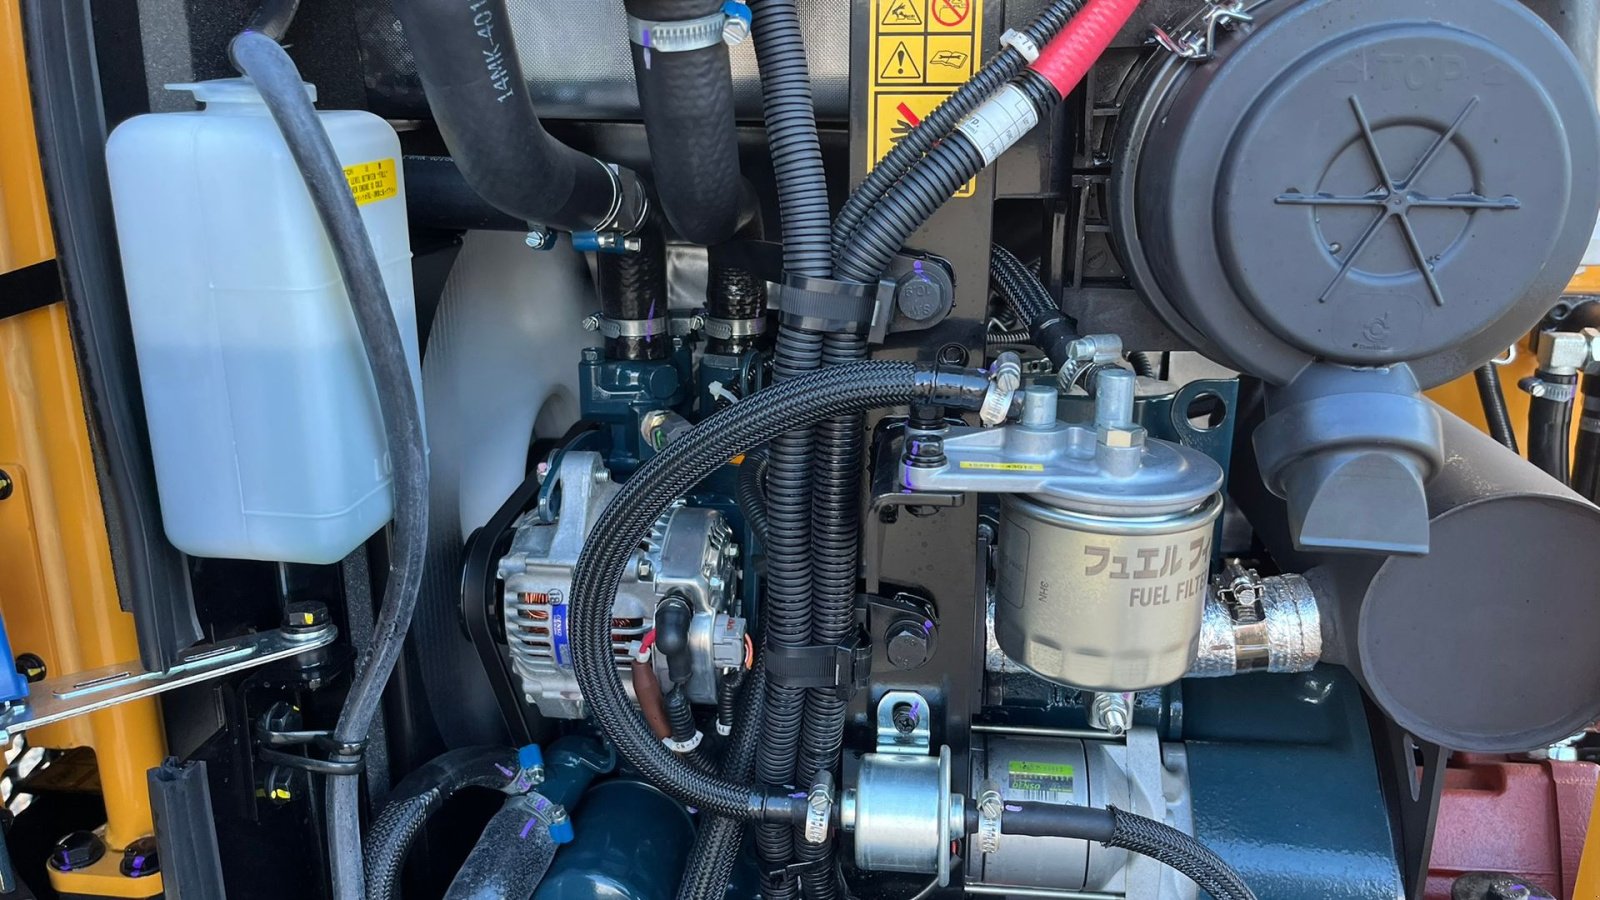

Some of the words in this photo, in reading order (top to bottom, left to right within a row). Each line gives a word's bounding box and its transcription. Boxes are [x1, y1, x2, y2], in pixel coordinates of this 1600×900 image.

[1377, 53, 1467, 91] TOP
[1129, 584, 1170, 608] FUEL
[1012, 781, 1041, 790] DENSO
